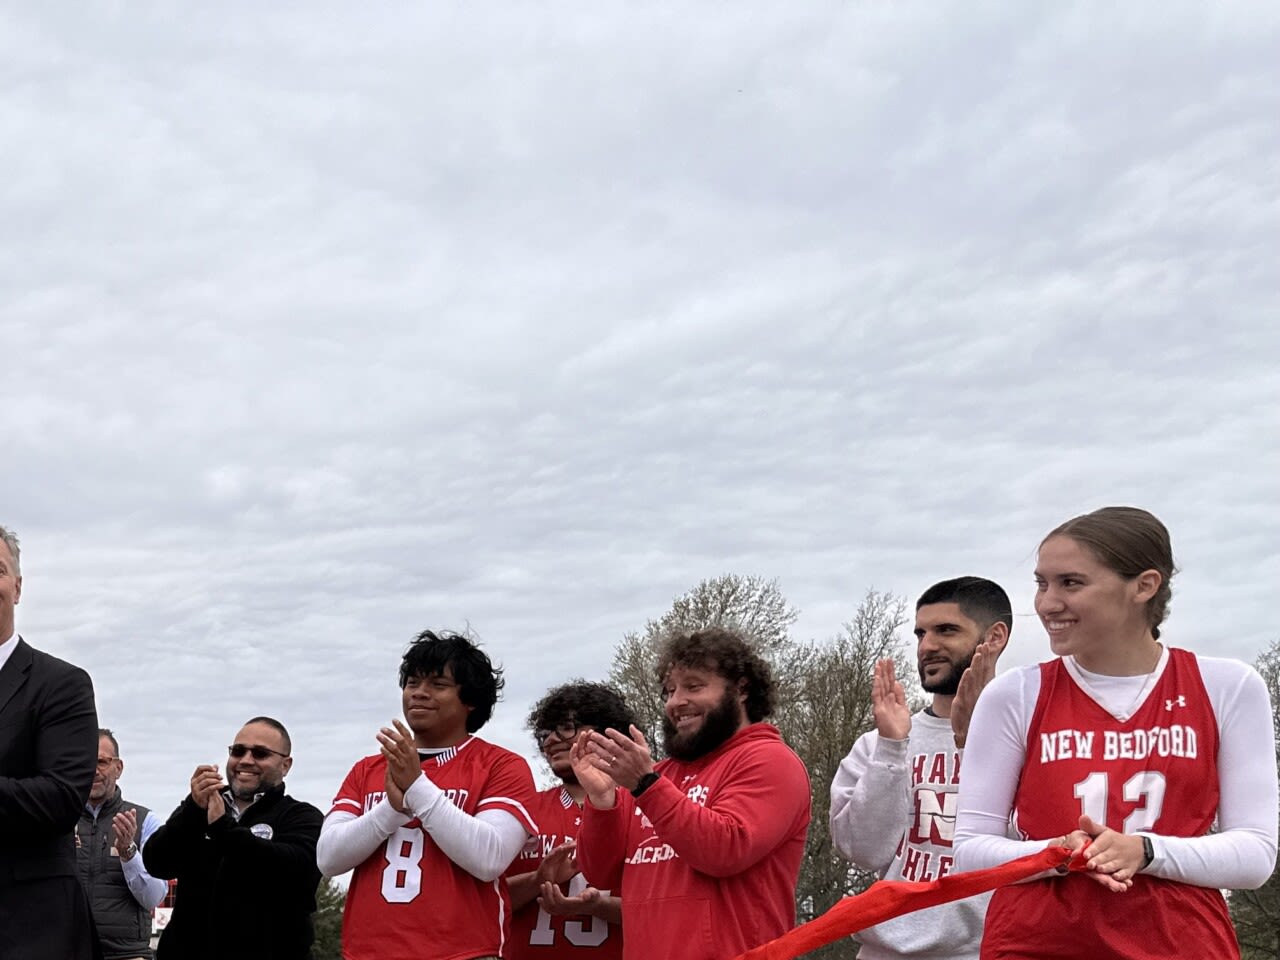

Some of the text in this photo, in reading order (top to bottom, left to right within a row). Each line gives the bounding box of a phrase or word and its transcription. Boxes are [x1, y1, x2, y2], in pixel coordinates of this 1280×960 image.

[1040, 725, 1198, 764] NEW BEDFORD
[1073, 770, 1167, 835] 12
[381, 826, 424, 903] 8
